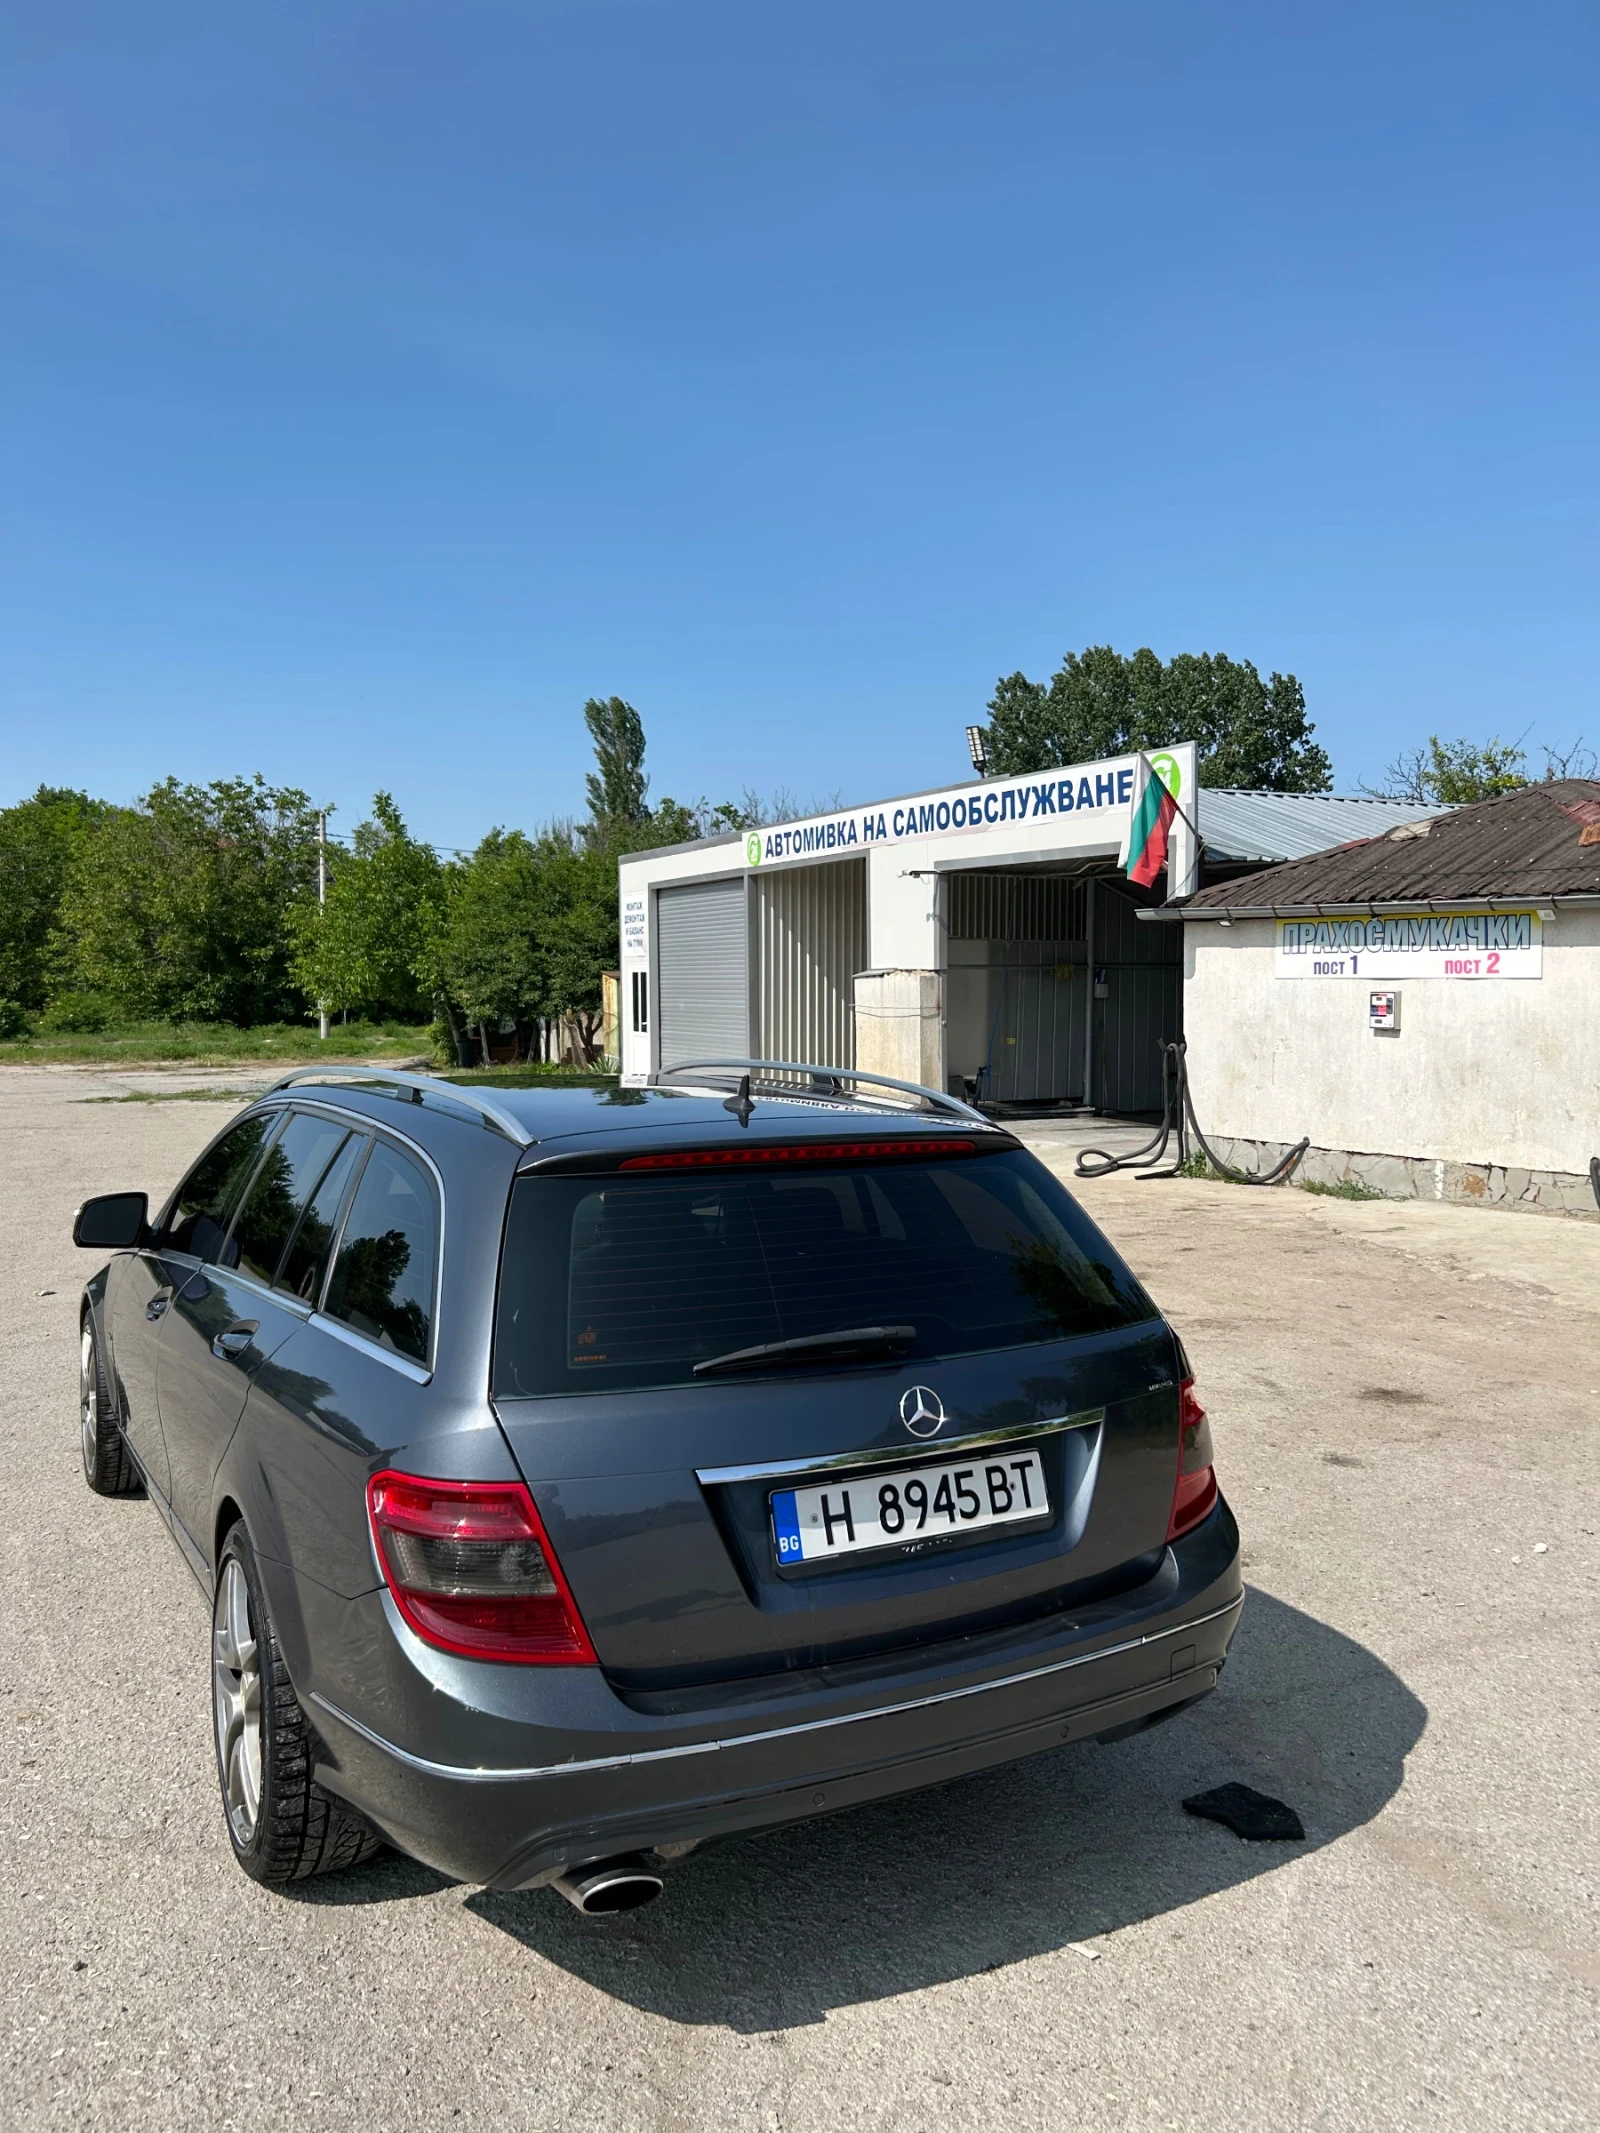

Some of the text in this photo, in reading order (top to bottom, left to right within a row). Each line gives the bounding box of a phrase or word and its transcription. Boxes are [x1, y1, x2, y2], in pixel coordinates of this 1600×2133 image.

[765, 768, 1134, 859] АВТОМИВКА НА САМООБСЛУЖВАНЕ
[1283, 914, 1531, 954] ПРАХОСМУКАЧКИ
[1350, 955, 1359, 975] 1
[1486, 953, 1501, 974] 2
[779, 1535, 799, 1553] BG
